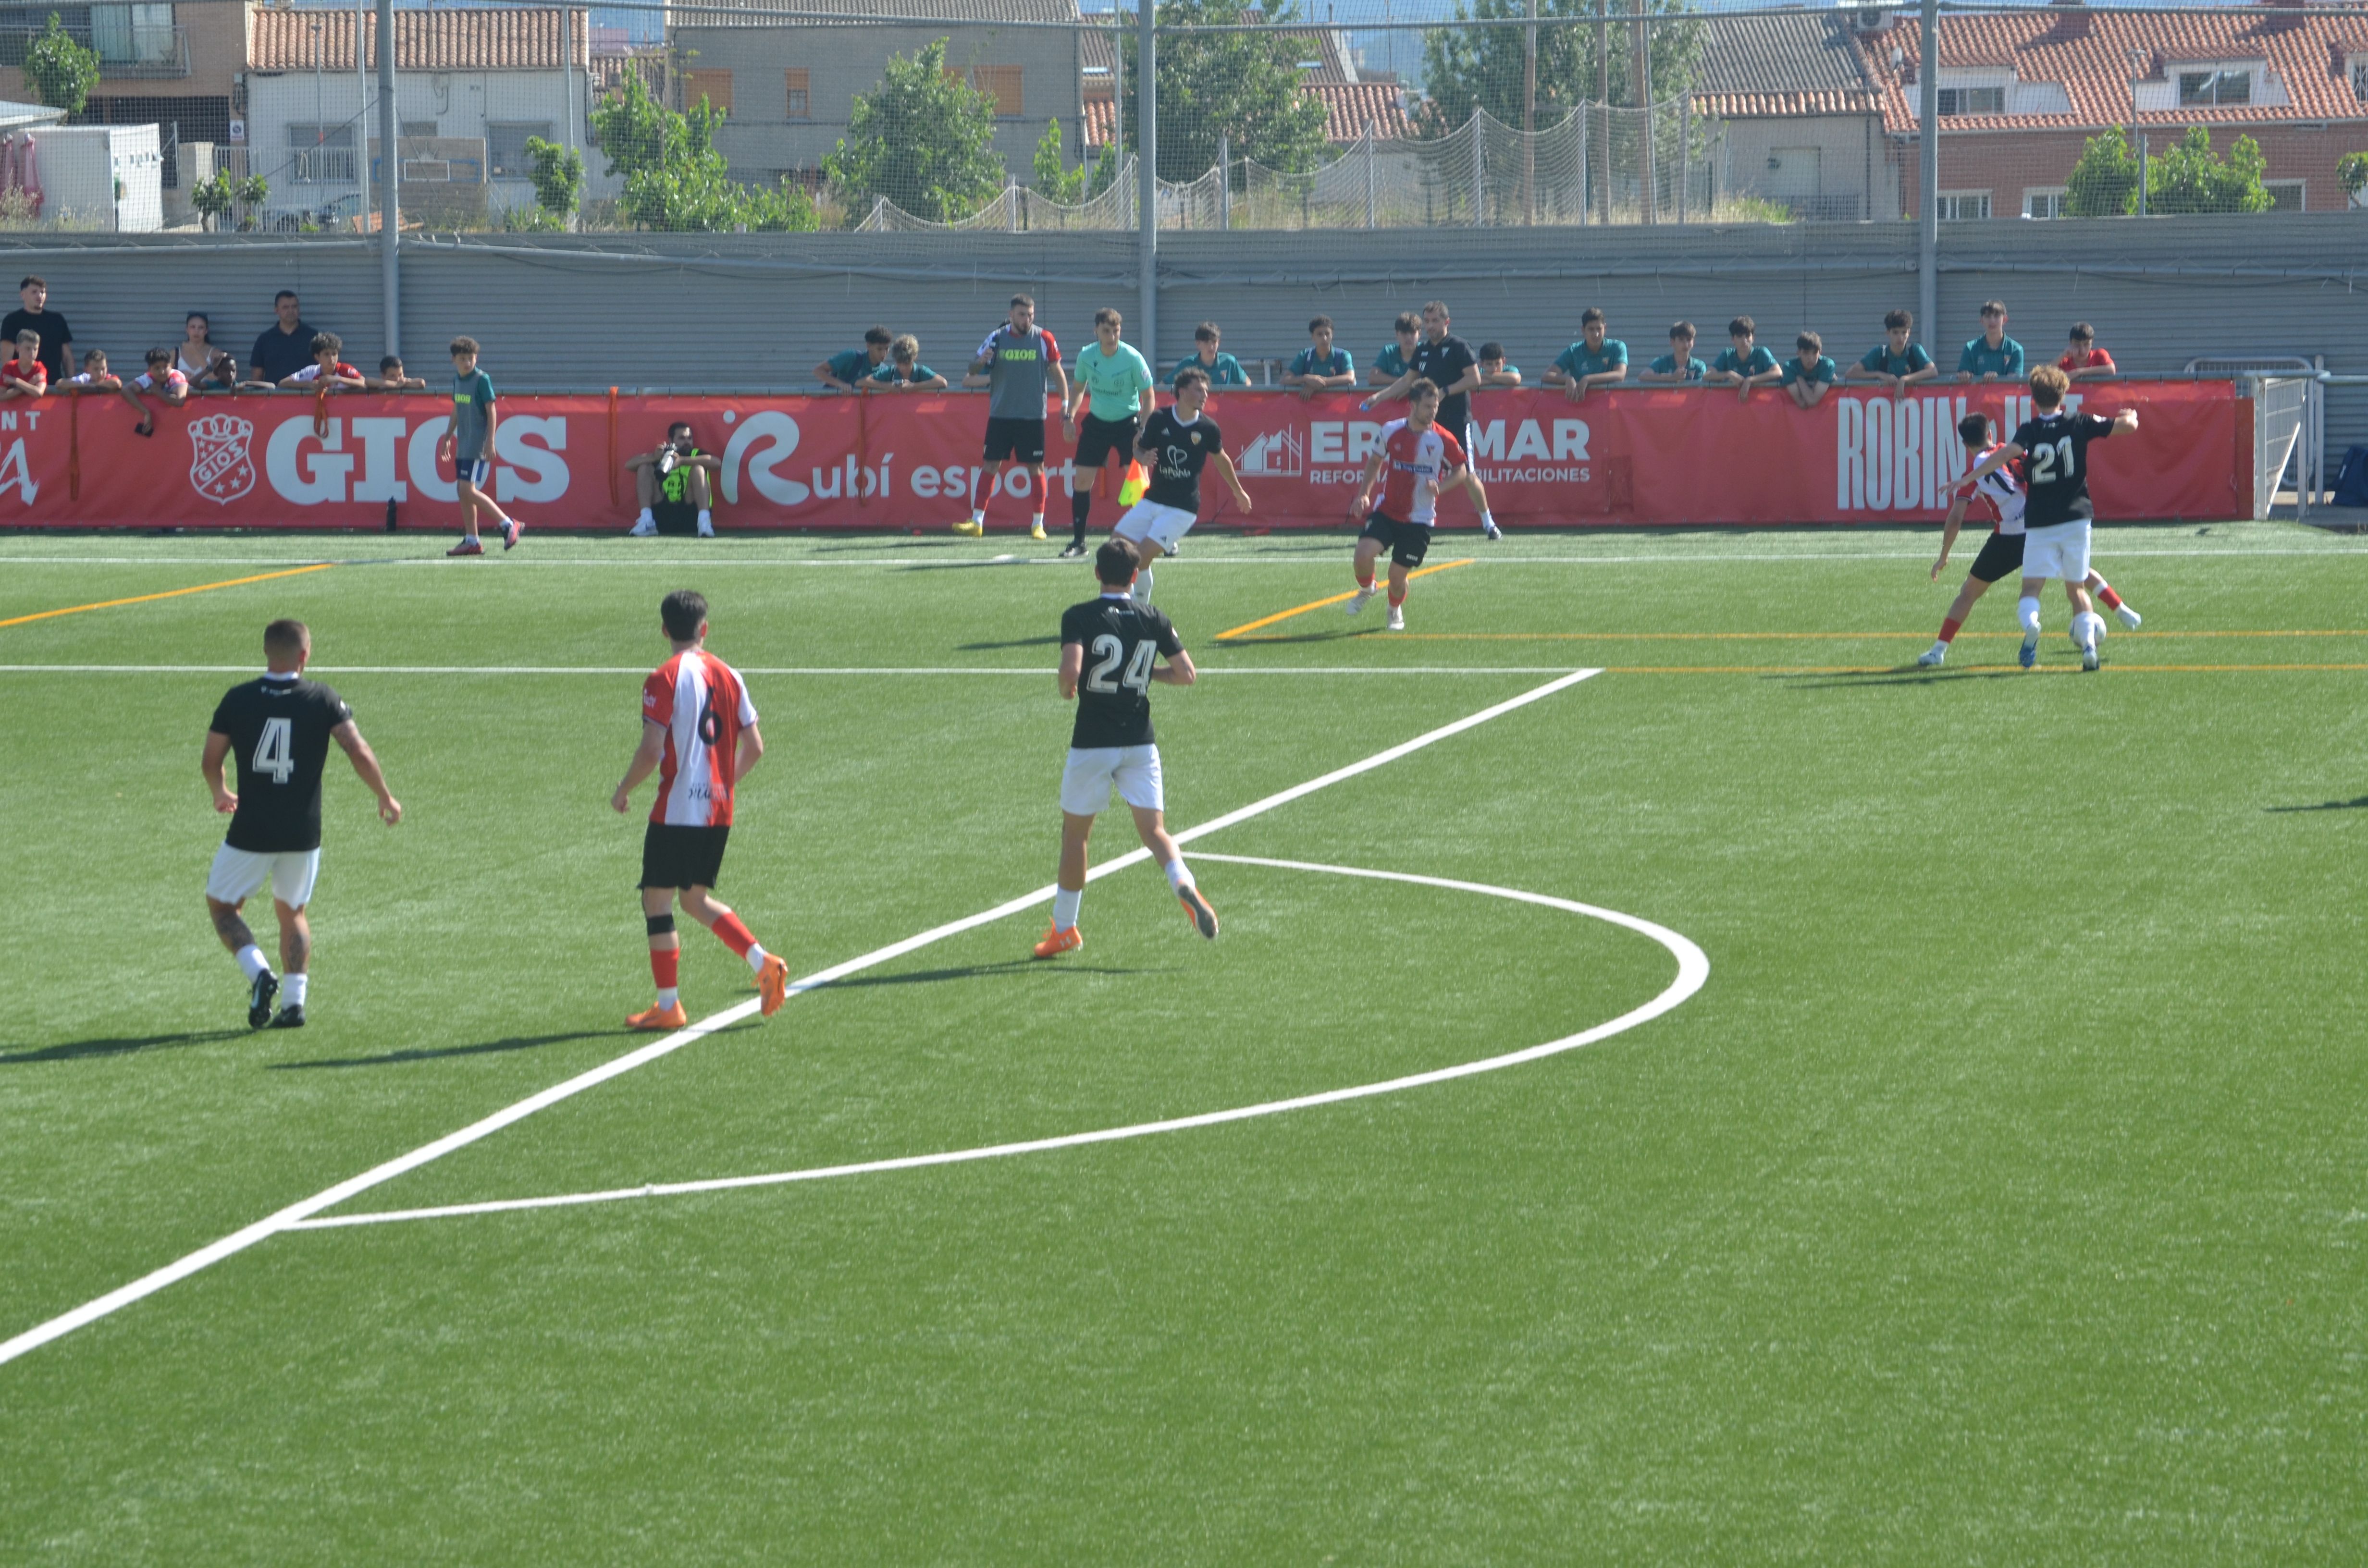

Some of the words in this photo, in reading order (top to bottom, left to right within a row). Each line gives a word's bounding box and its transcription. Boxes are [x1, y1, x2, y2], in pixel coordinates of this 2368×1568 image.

[1005, 349, 1036, 361] GIOS
[455, 393, 471, 405] IOS
[198, 440, 243, 481] GIOS
[266, 415, 570, 506] GIOS
[721, 410, 894, 506] Rubí
[1837, 396, 1967, 510] ROBIN
[2032, 435, 2074, 484] 21
[1086, 634, 1157, 697] 24
[698, 686, 723, 746] 6
[252, 717, 294, 784] 4
